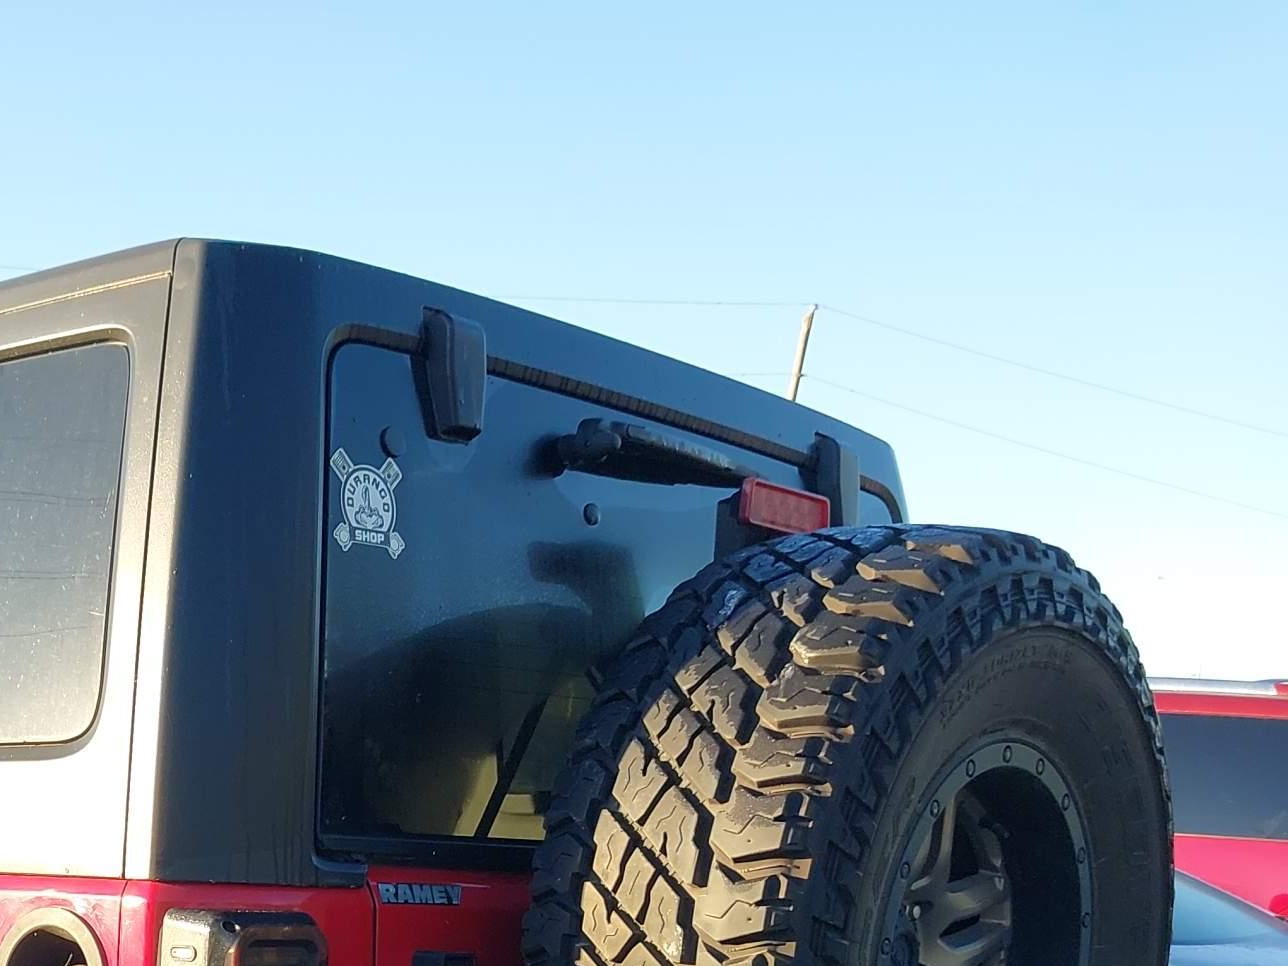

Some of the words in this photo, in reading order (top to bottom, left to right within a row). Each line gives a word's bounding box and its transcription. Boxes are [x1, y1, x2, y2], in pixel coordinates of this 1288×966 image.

[346, 473, 391, 513] DURANGO
[354, 530, 385, 544] SHOP
[378, 883, 461, 905] RAMEY
